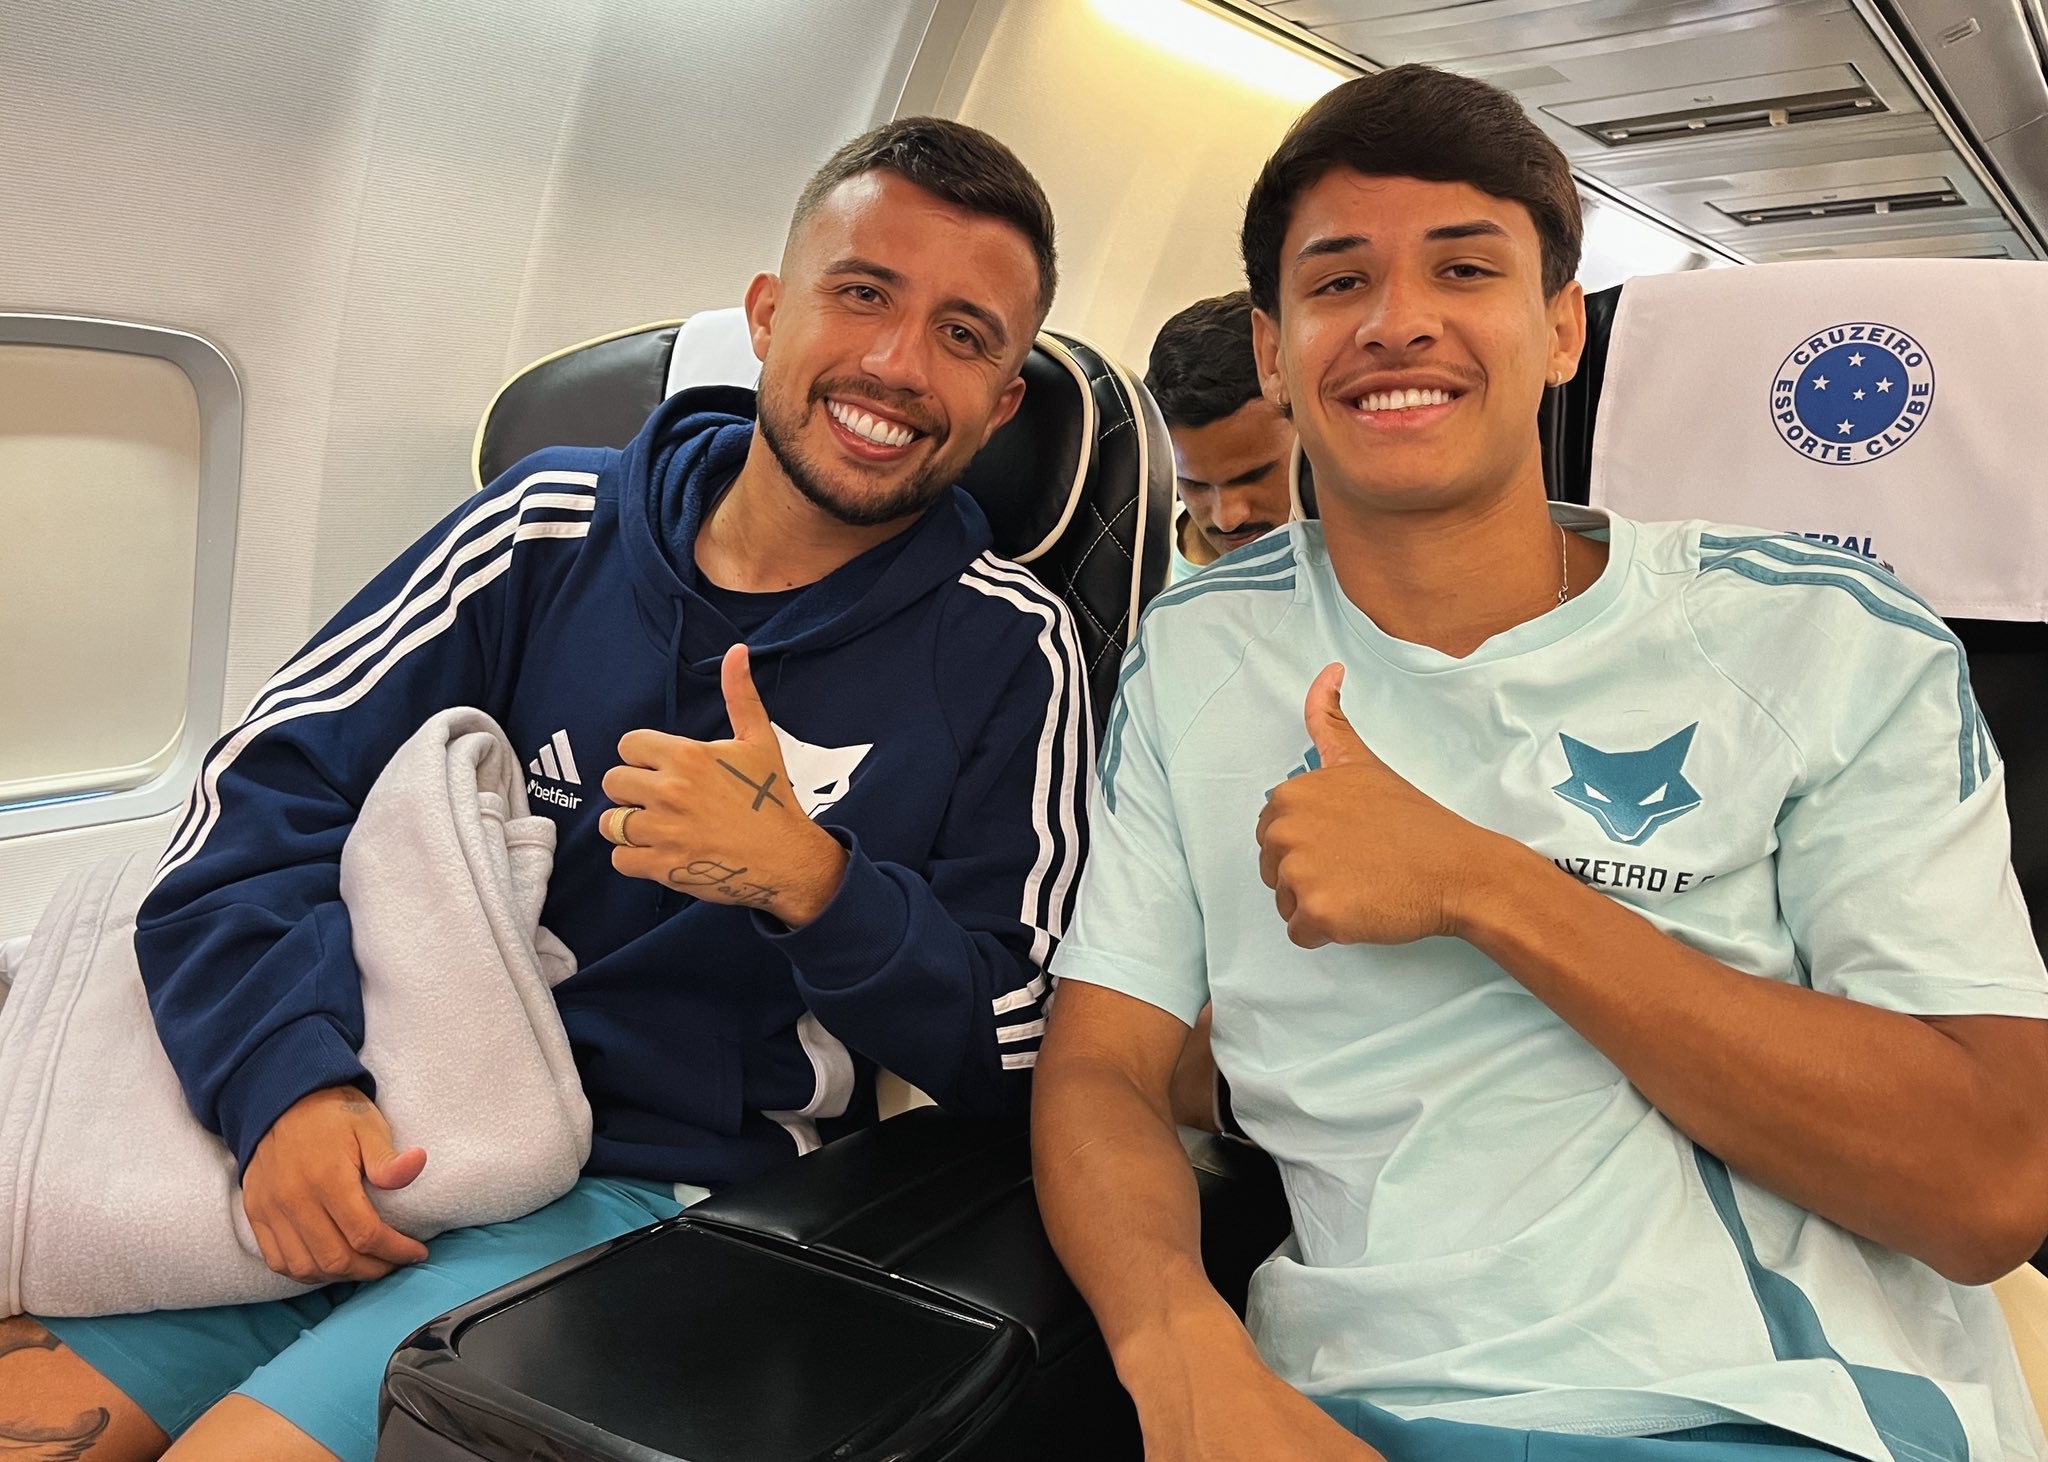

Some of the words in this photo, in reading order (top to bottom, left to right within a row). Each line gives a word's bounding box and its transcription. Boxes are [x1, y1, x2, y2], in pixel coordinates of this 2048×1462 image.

[1793, 326, 1923, 367] CRUZEIRO
[1775, 379, 1852, 461] ESPORTE
[1866, 382, 1930, 456] CLUBE
[534, 781, 583, 810] betfair
[1548, 857, 1668, 893] UZEIRO
[1673, 871, 1694, 894] E
